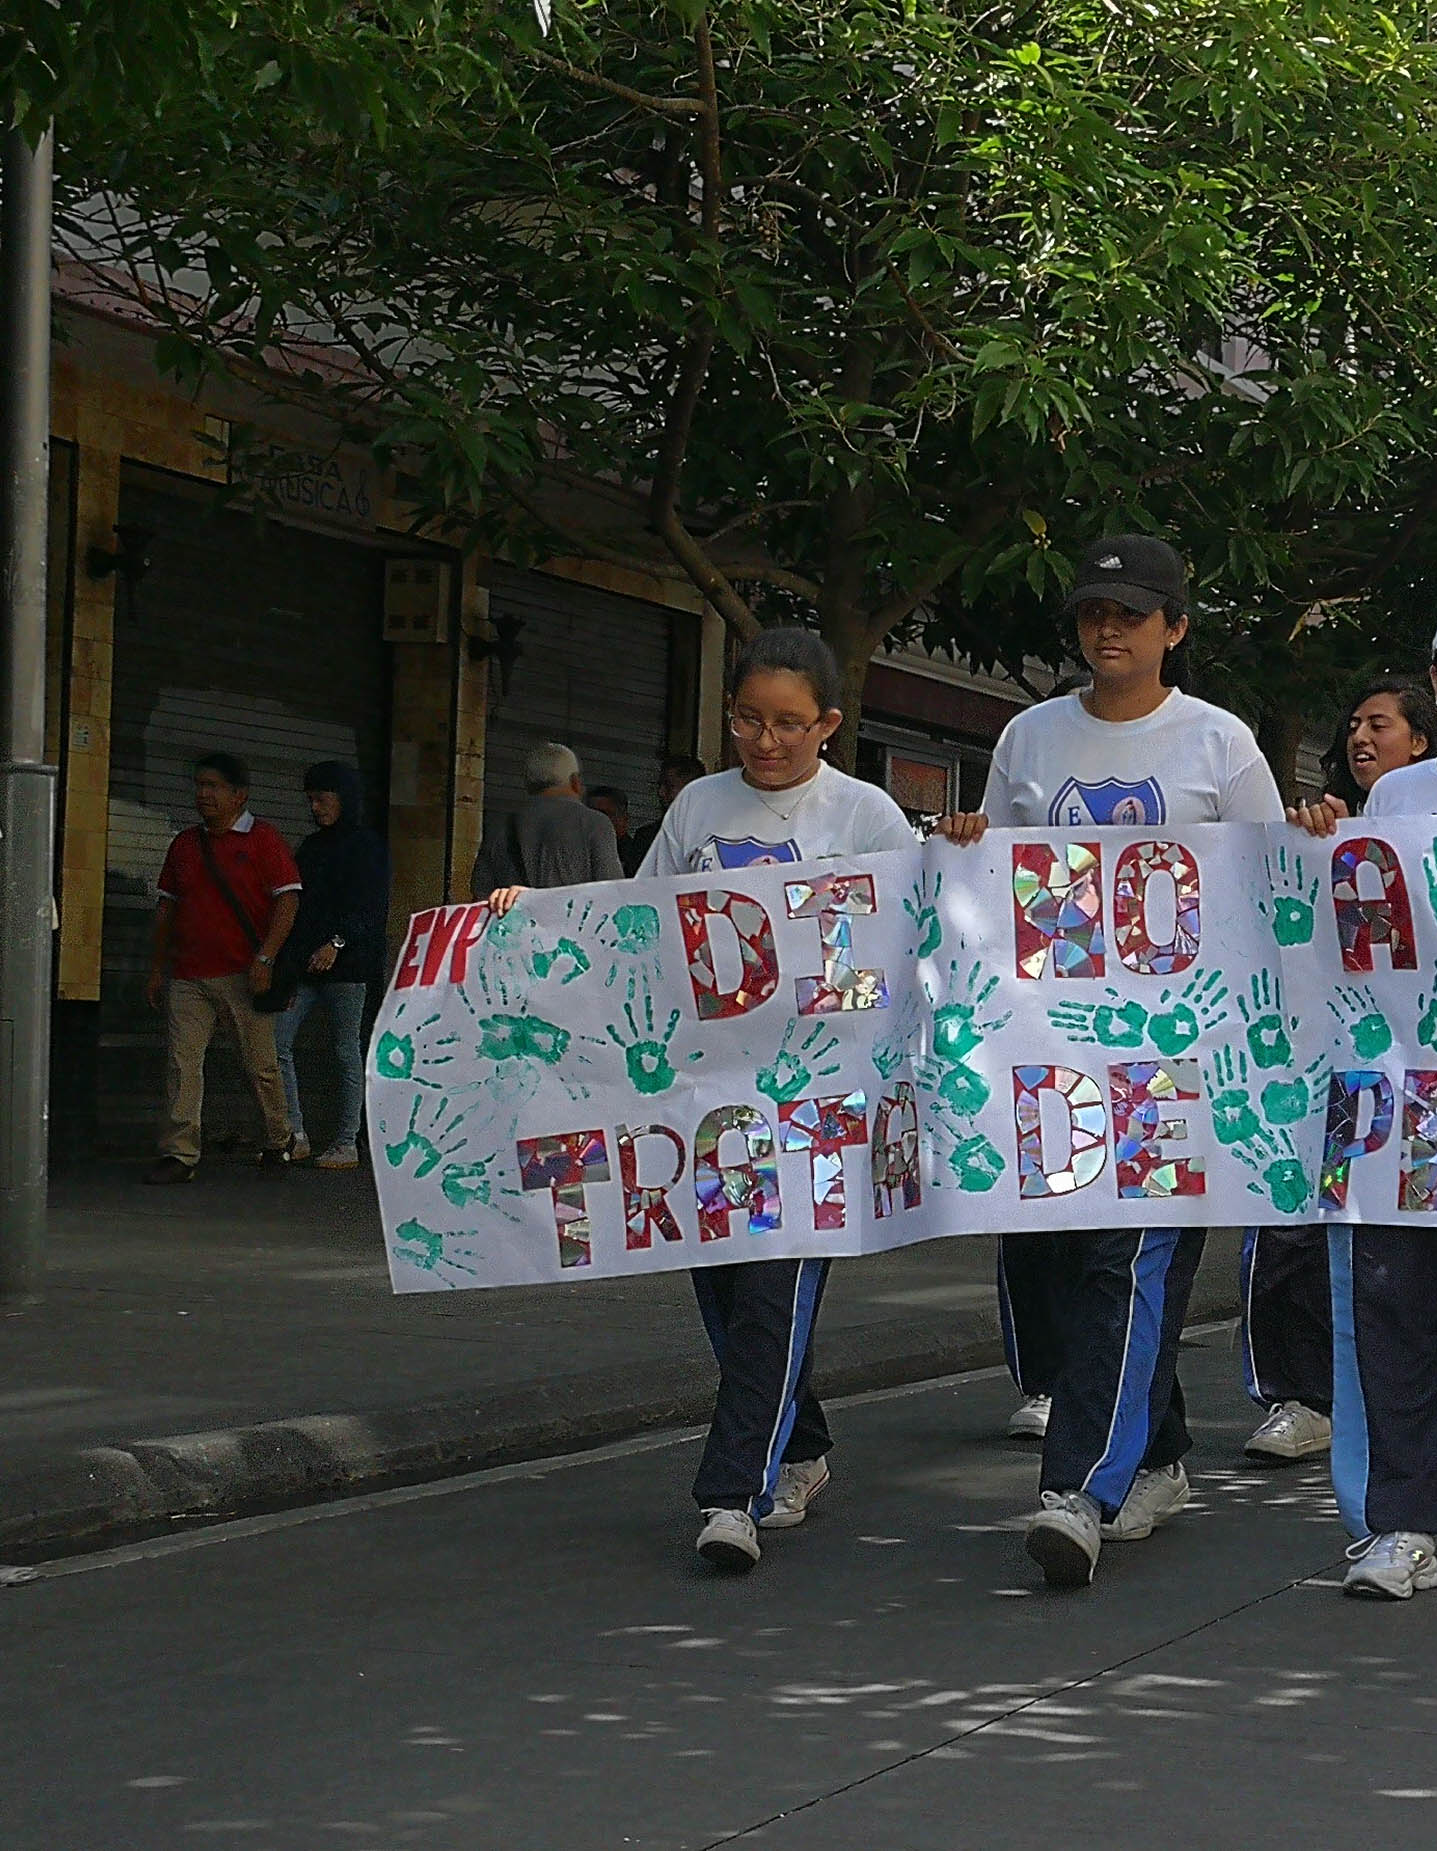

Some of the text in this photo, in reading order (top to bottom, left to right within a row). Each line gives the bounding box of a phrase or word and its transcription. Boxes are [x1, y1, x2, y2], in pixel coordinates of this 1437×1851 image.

[676, 873, 890, 1020] DI
[1012, 841, 1200, 979] NO
[1331, 837, 1418, 972] A
[517, 1081, 922, 1268] TRATA
[1012, 1058, 1206, 1200] DE
